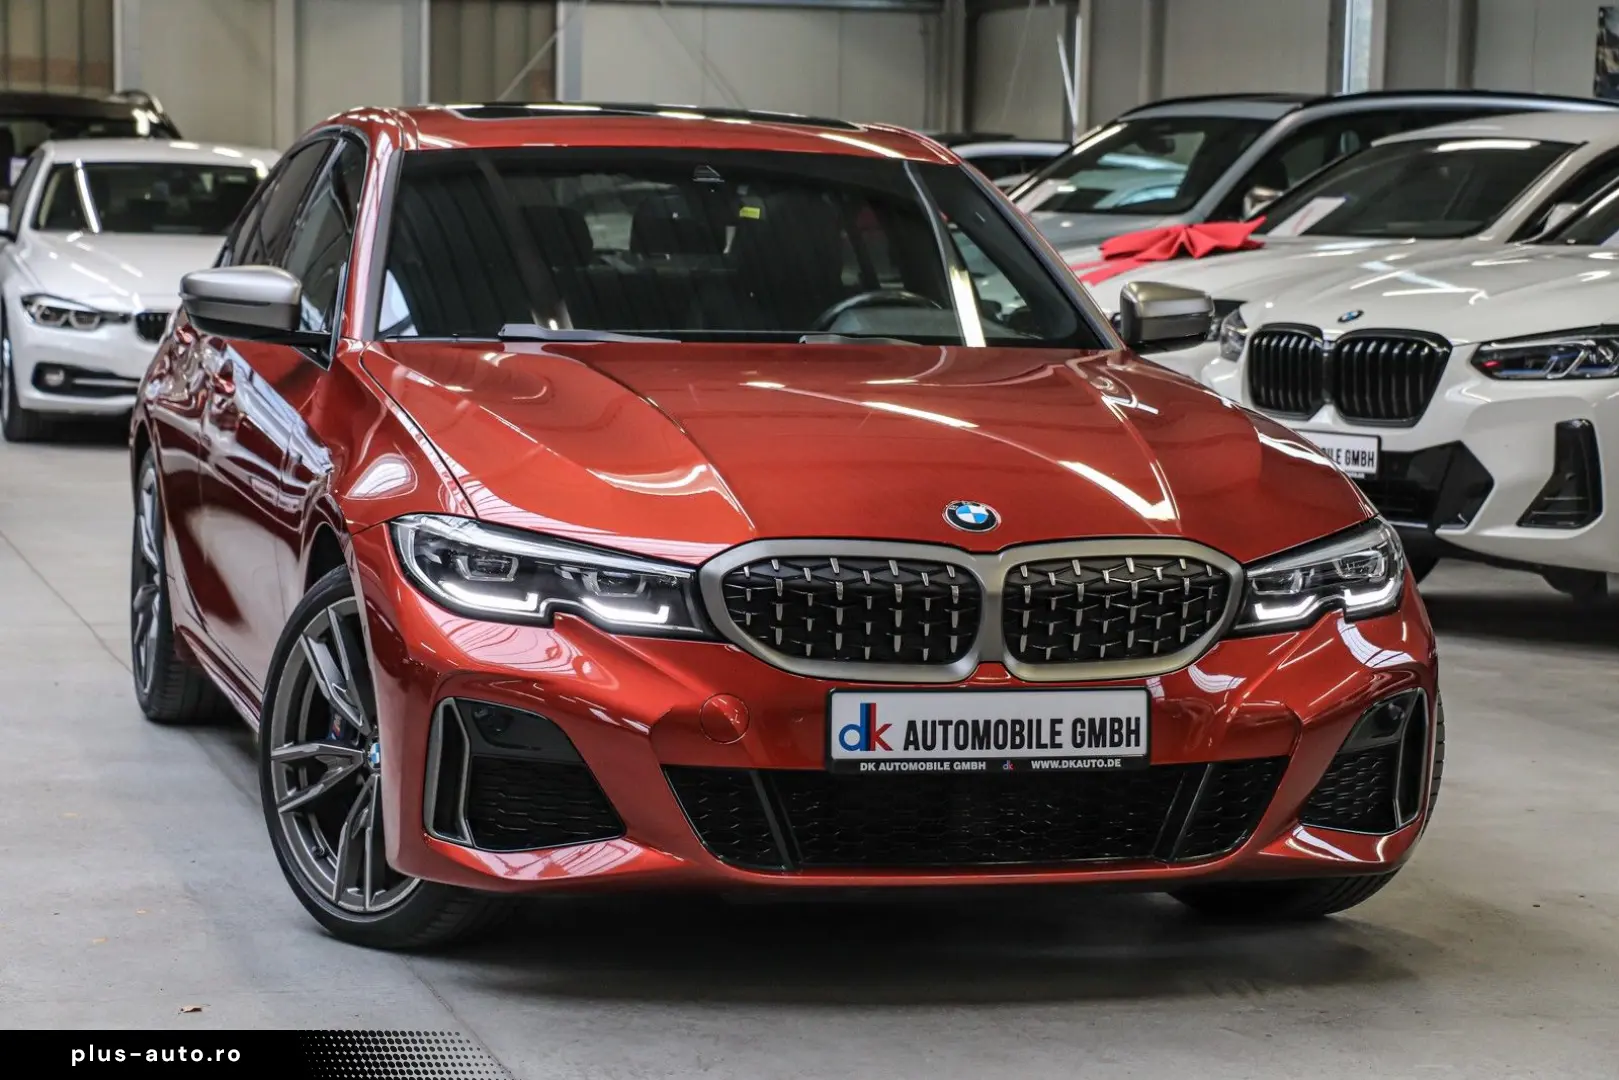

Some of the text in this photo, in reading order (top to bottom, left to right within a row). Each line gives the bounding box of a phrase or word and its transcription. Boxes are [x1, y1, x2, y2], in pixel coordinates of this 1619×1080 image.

[1345, 449, 1374, 468] GMBH
[839, 702, 1141, 751] dk AUTOMOBILE GMBH
[860, 762, 876, 771] DK
[878, 762, 950, 771] AUTOMOBILE
[953, 761, 986, 770] GMBH
[1031, 759, 1121, 769] WWW.DKAUTO.DE
